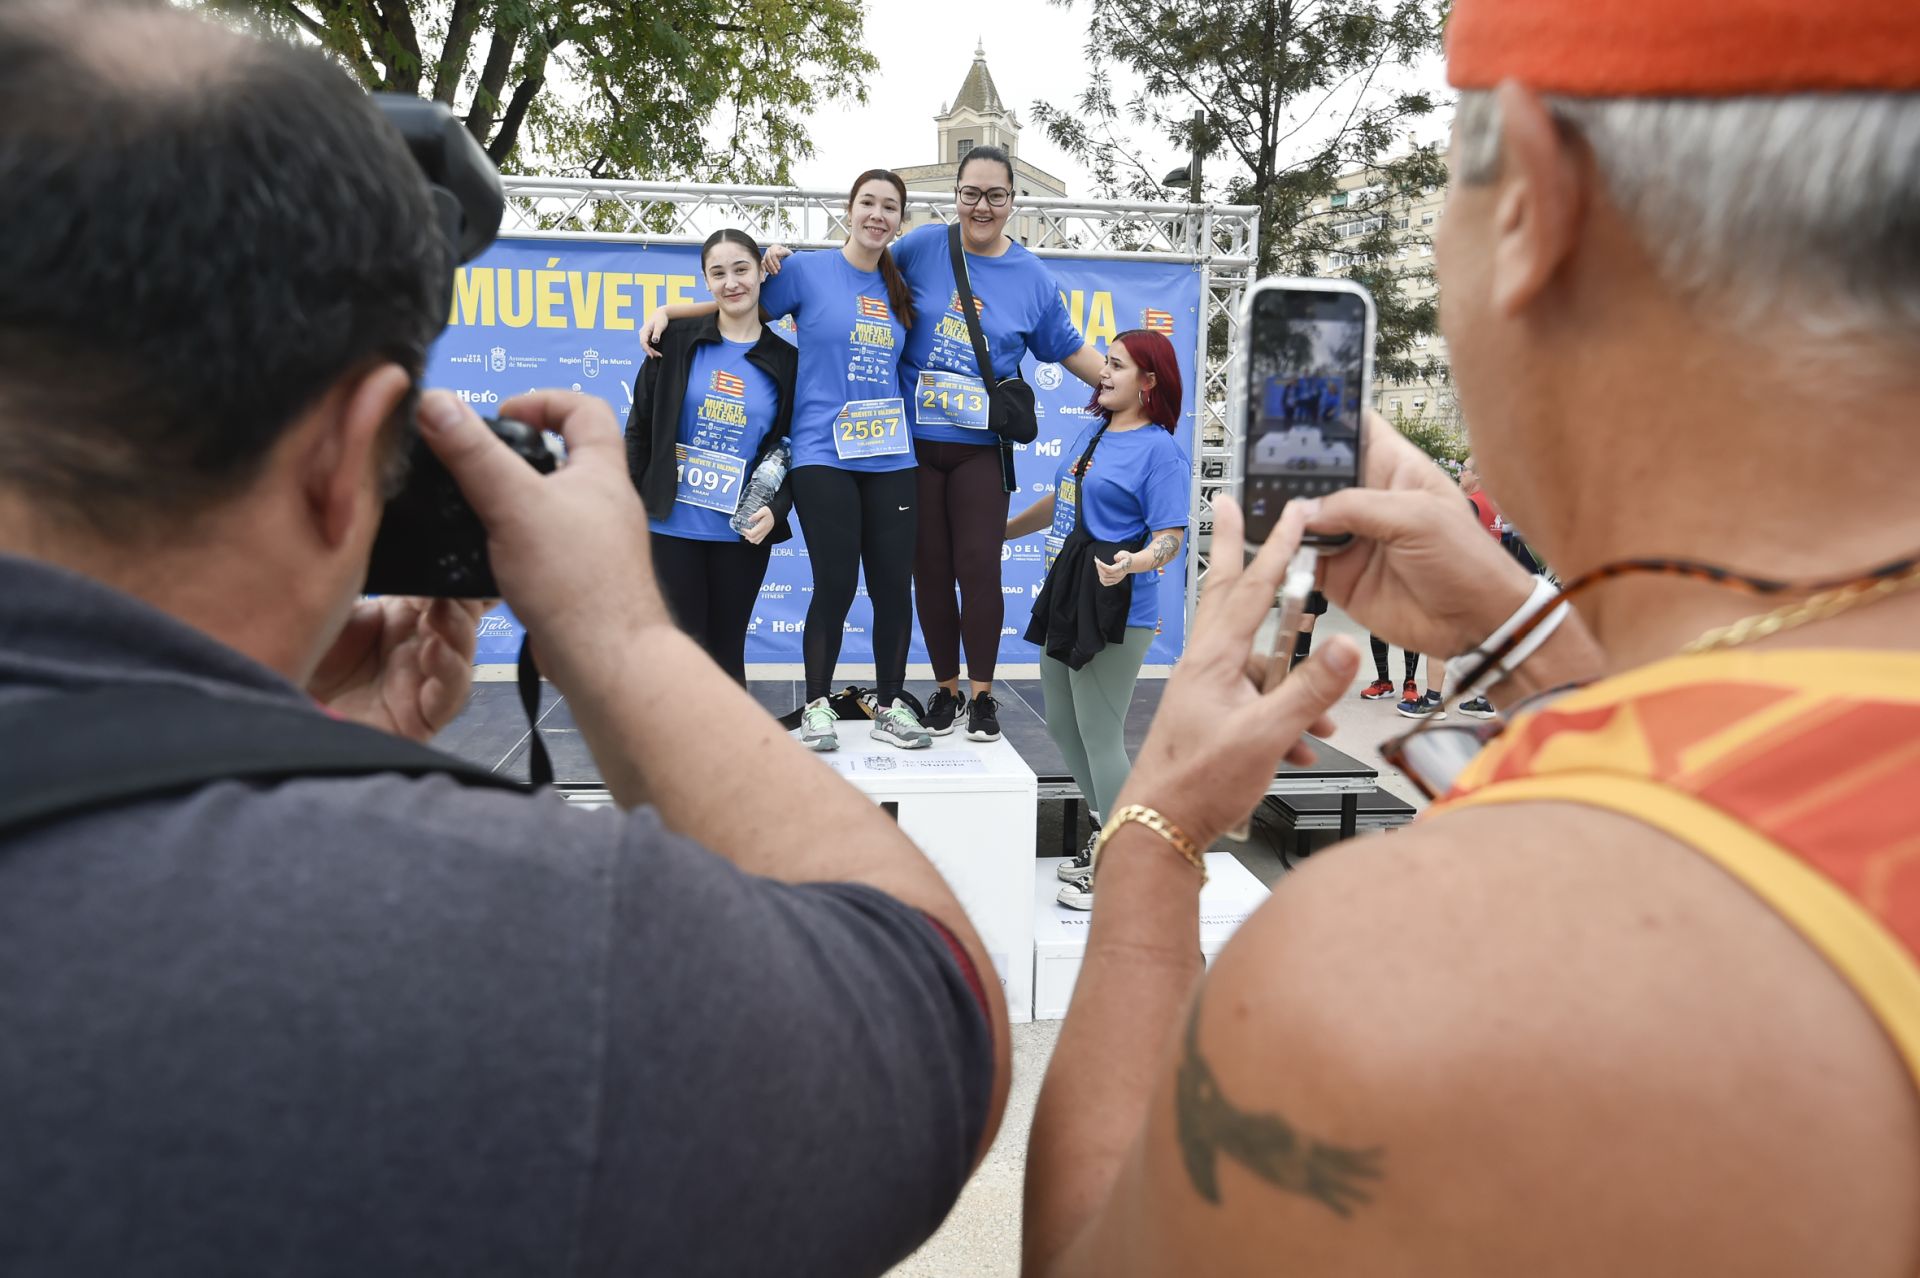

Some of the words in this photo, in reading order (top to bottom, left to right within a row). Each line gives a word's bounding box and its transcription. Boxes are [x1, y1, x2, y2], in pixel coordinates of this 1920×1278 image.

[447, 257, 696, 331] MUÉVETE
[456, 389, 498, 403] Hero
[922, 390, 983, 411] 2113
[705, 407, 747, 426] VALENCIA
[840, 417, 899, 441] 2567
[676, 464, 737, 494] 1097
